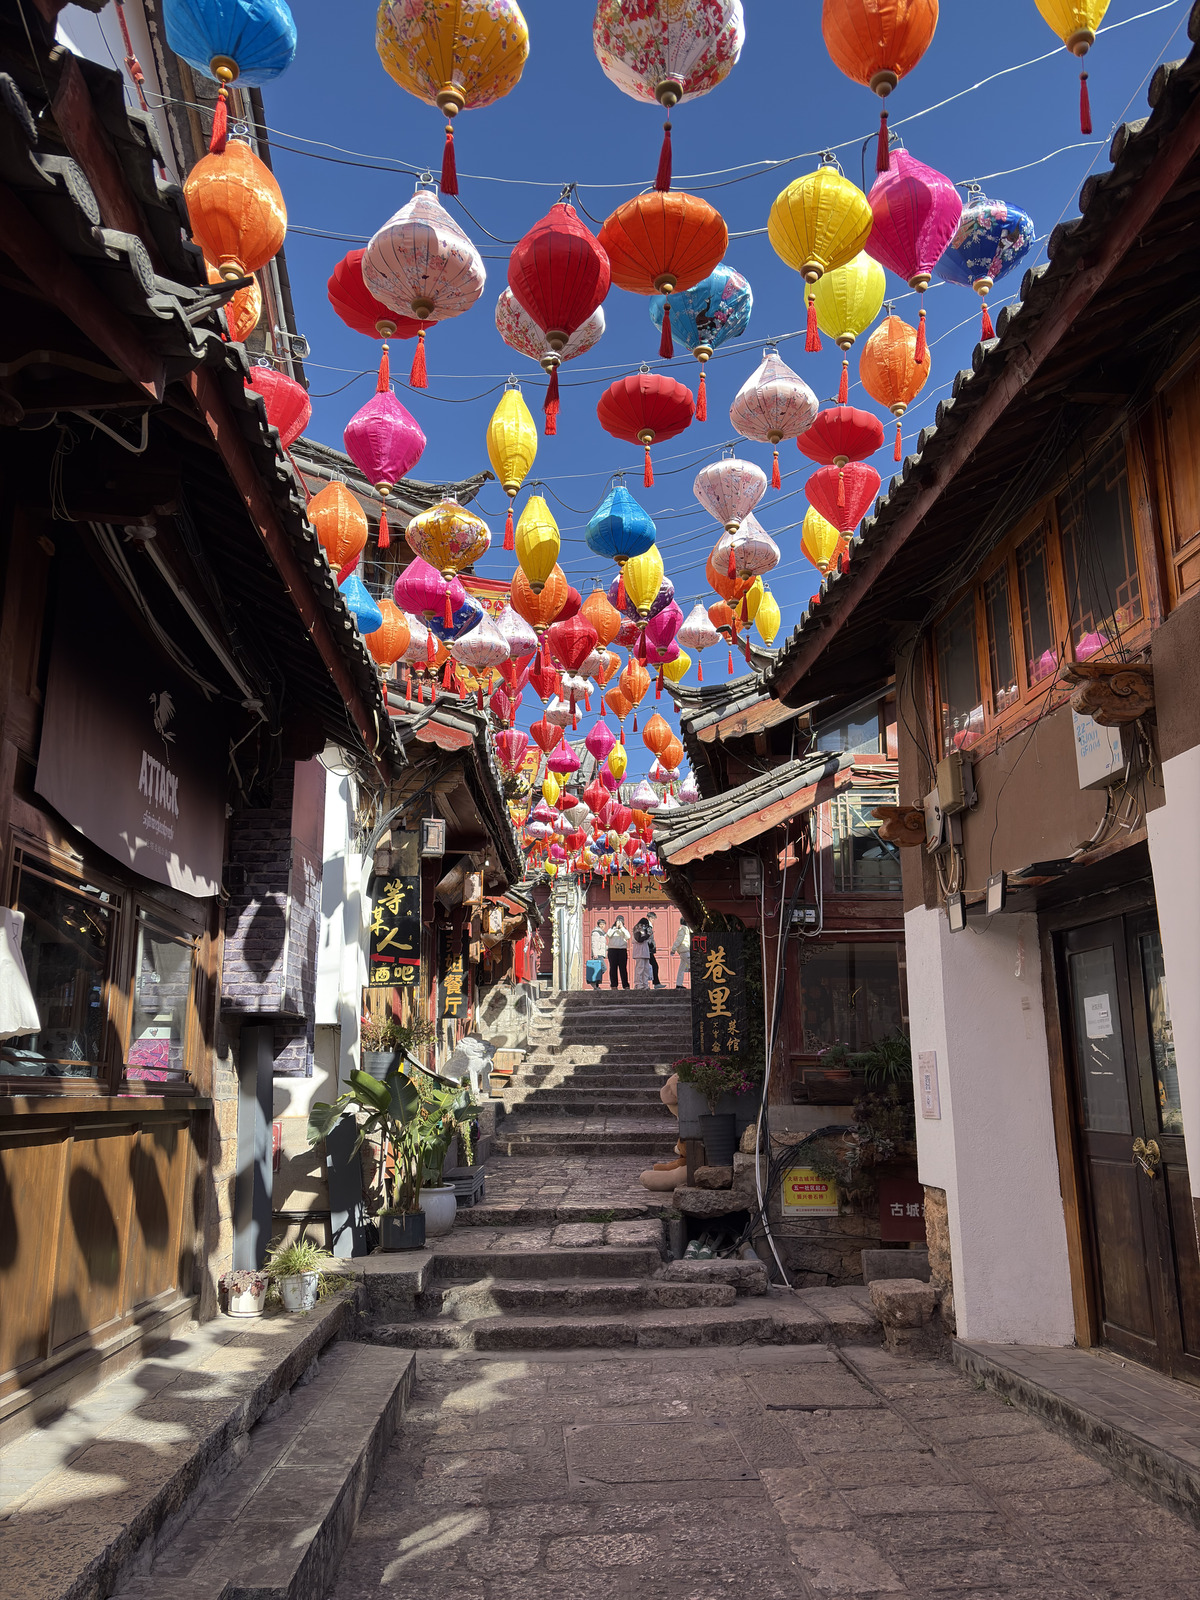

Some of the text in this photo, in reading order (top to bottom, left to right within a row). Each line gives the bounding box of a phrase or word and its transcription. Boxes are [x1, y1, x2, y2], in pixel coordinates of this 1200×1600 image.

[138, 750, 179, 819] ATTACK
[614, 882, 667, 895] 润甜水
[370, 878, 412, 952] 等某人
[370, 965, 415, 982] 酒吧
[701, 945, 736, 1018] 巷里
[726, 1019, 741, 1052] 菜馆
